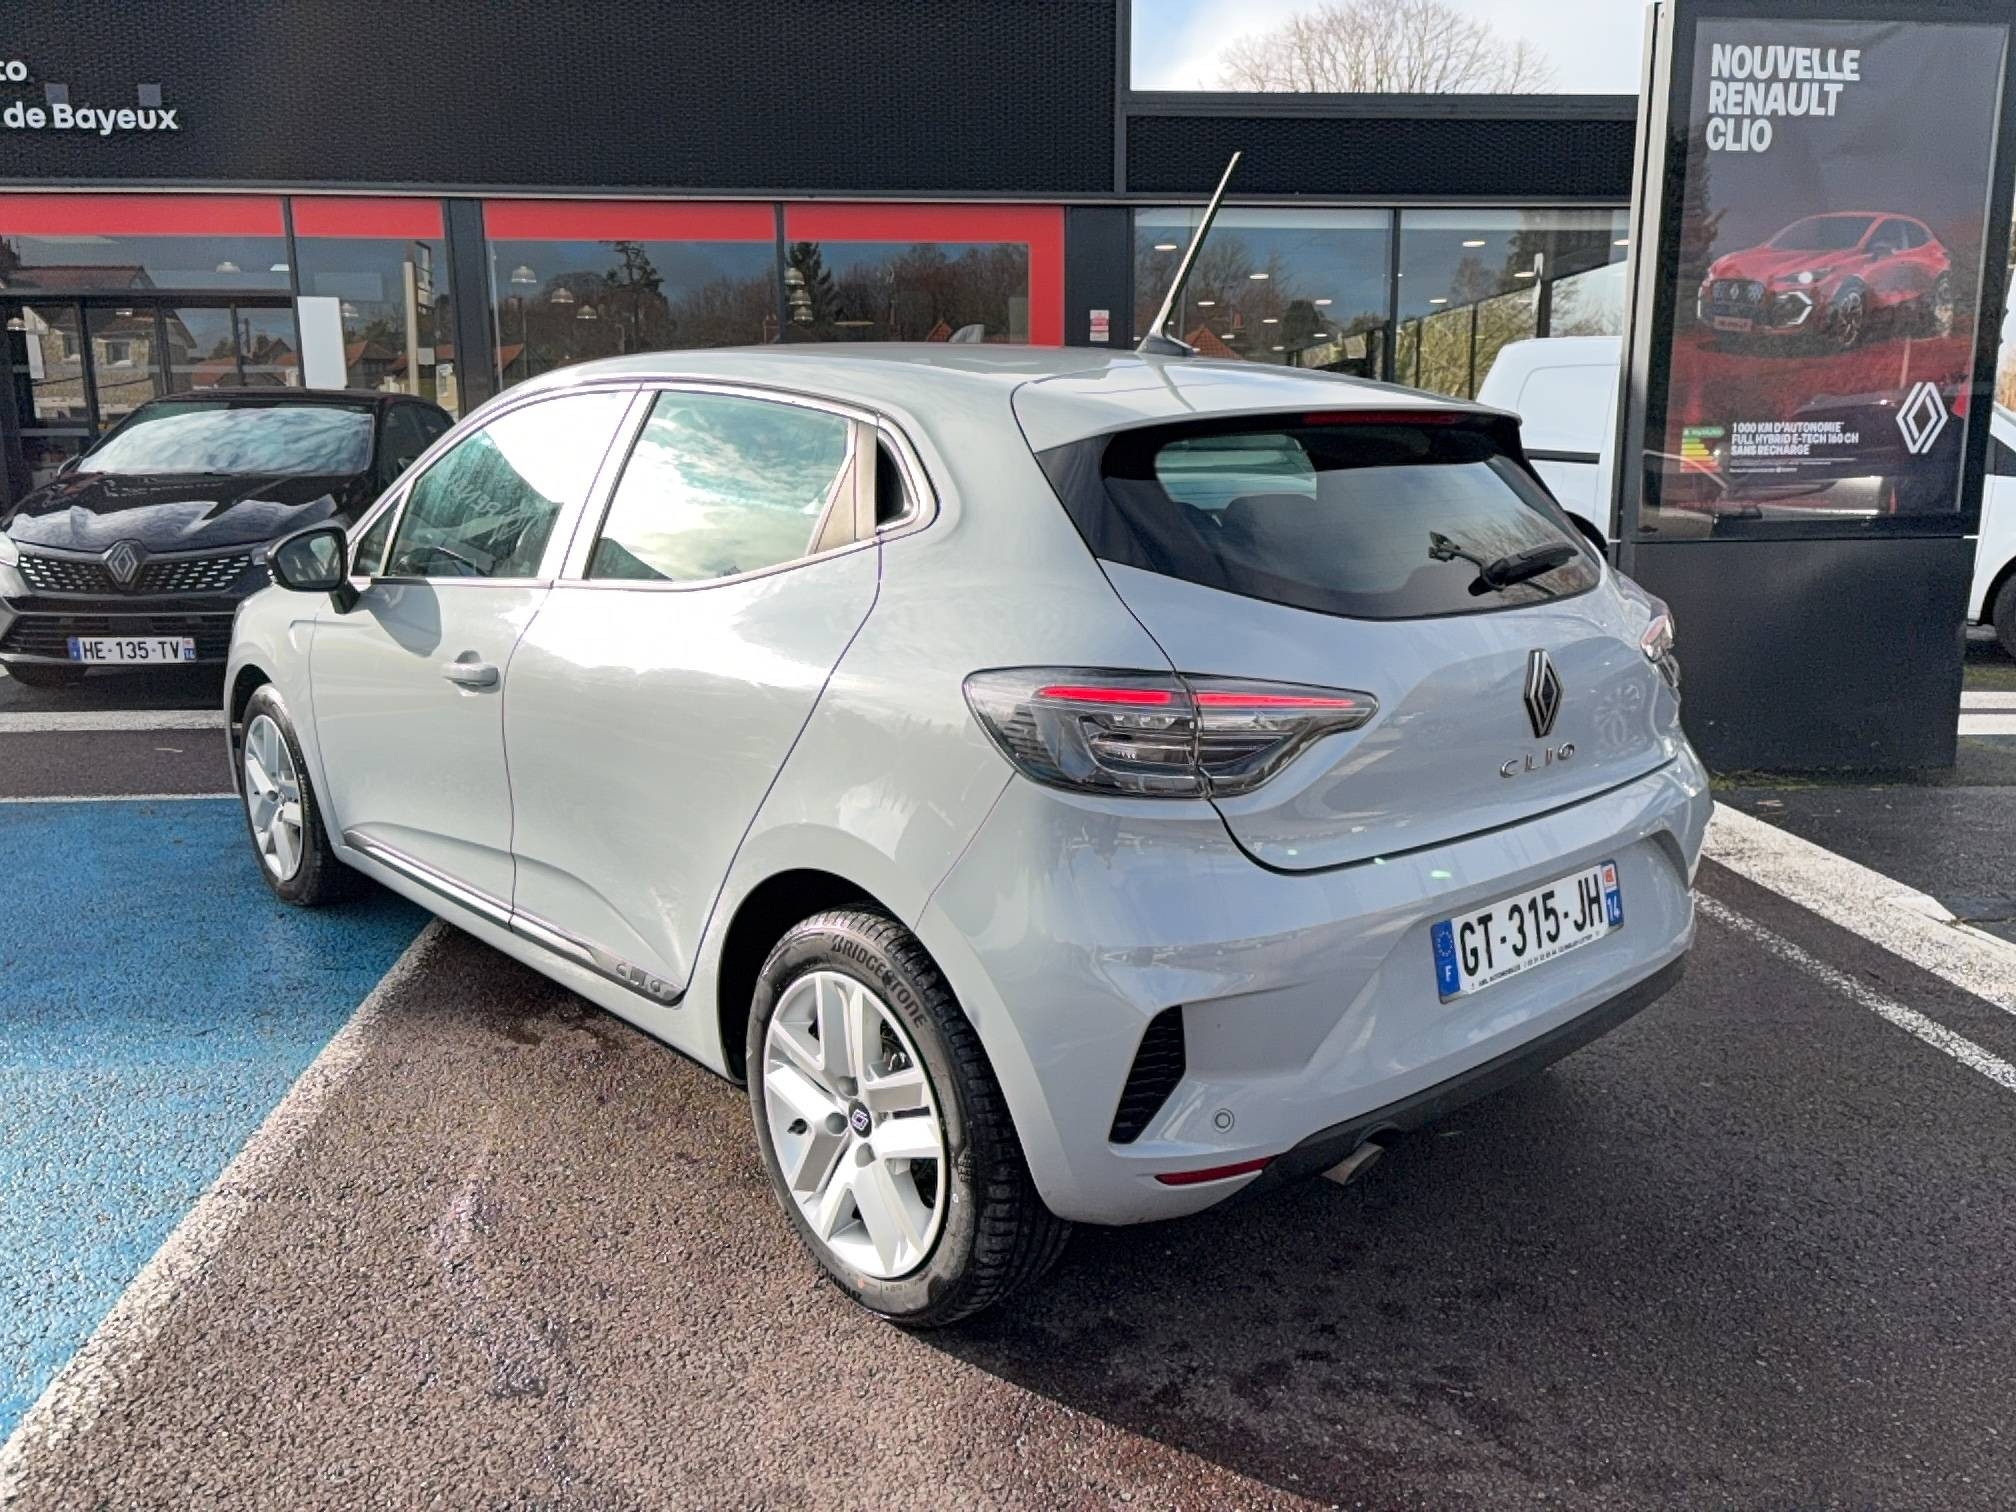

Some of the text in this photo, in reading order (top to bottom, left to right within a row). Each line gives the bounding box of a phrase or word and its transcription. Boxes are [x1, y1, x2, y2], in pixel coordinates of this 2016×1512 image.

[1711, 43, 1860, 81] NOUVELLE
[1708, 81, 1843, 116] RENAULT
[3, 101, 179, 135] de Bayeux
[1706, 117, 1773, 152] CLIO
[1731, 433, 1753, 445] FULL
[1756, 433, 1790, 445] HYBRID
[1792, 433, 1826, 444] E-TECH
[1758, 422, 1773, 433] KM
[1731, 444, 1810, 456] SANS RECHARGE
[82, 641, 180, 660] HE-135-TV
[1500, 742, 1575, 778] CLIO
[1460, 873, 1603, 977] GT-315-JH
[1445, 965, 1453, 982] F
